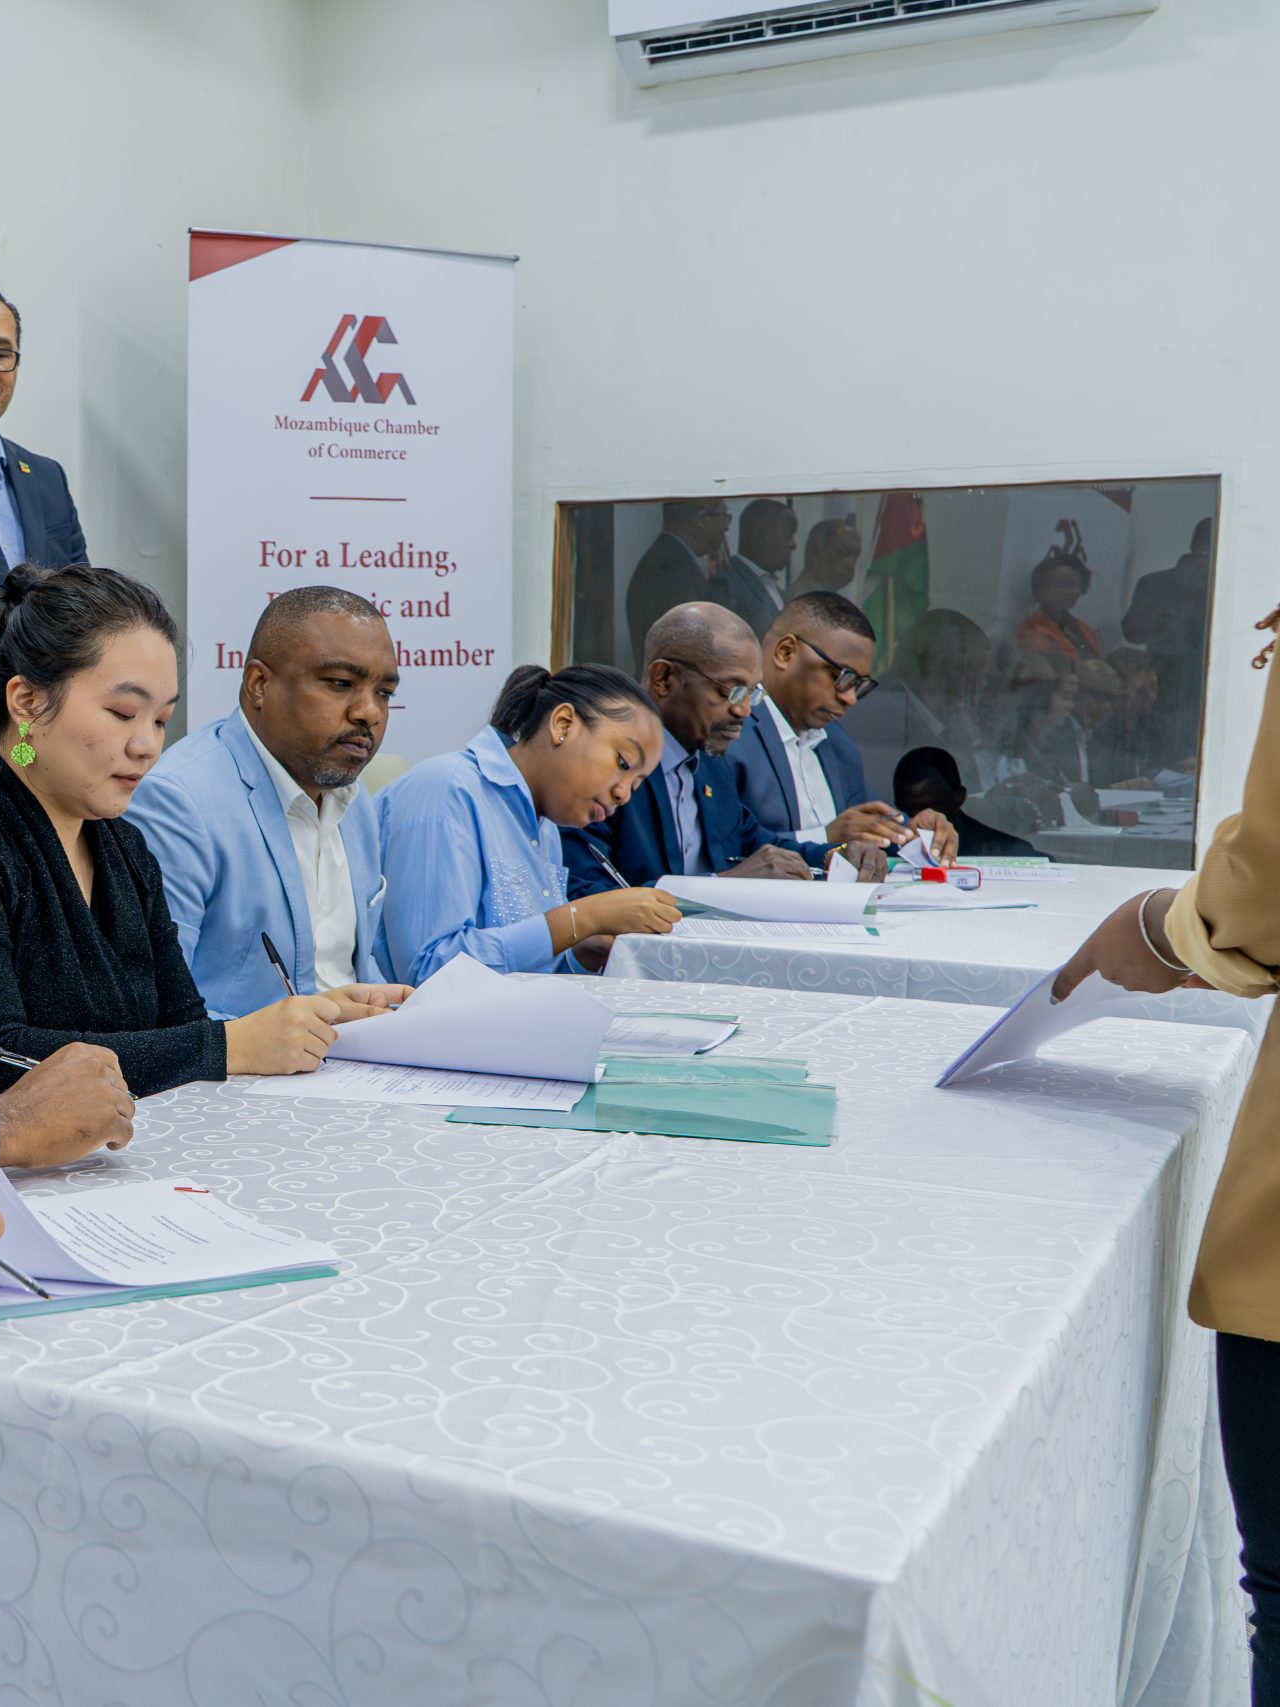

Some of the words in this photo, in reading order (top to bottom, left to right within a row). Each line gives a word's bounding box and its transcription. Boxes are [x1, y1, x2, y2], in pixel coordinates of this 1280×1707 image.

[274, 415, 370, 437] Mozambique
[374, 418, 440, 436] Chamber
[308, 443, 325, 458] of
[327, 443, 407, 460] Commerce
[258, 540, 307, 568] For
[315, 549, 331, 568] a
[339, 541, 458, 578] Leading,
[400, 591, 451, 618] and
[396, 640, 495, 667] hamber
